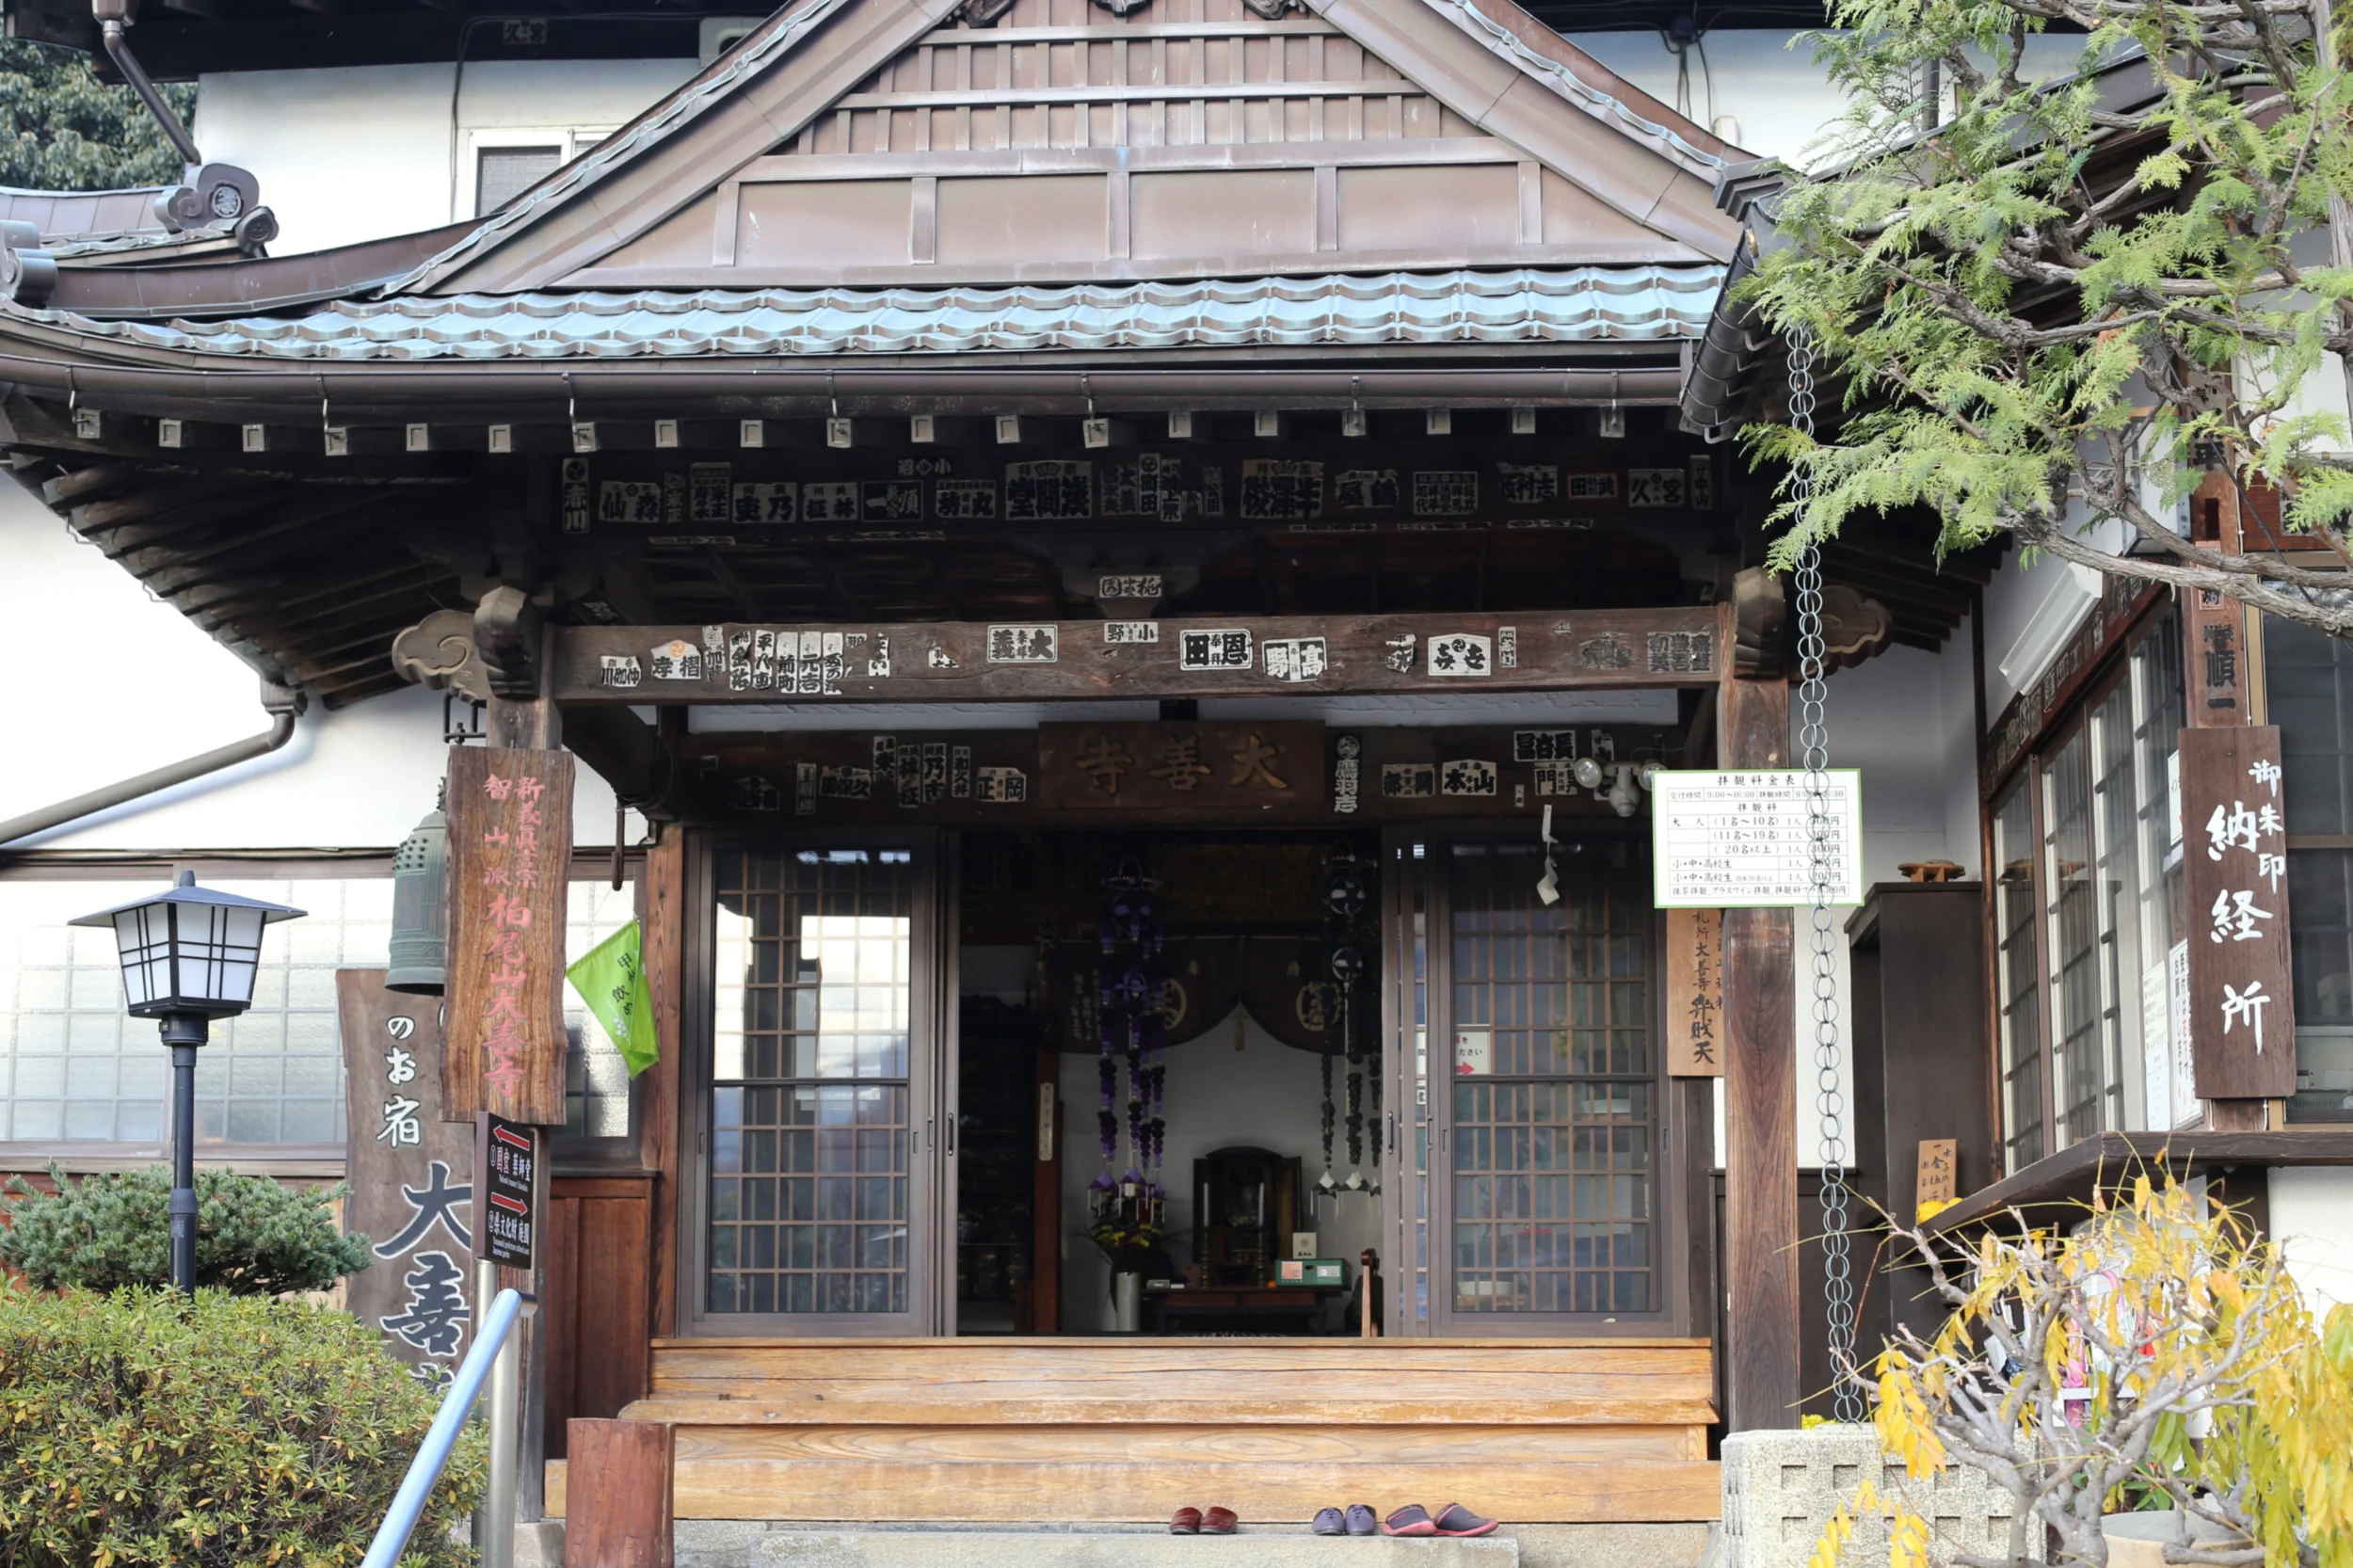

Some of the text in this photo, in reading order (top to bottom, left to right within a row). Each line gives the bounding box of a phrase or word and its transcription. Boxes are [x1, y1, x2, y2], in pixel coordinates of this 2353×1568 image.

[1108, 624, 1155, 641] 小野
[777, 655, 795, 691] 前町
[800, 653, 820, 690] 元吉
[2206, 649, 2240, 710] 順一
[1074, 732, 1288, 795] 大善寺
[1444, 768, 1494, 793] 山本
[1717, 775, 1795, 786] 拝観料金表
[976, 776, 1024, 801] 岡正
[1737, 803, 1777, 813] 拝観料
[484, 773, 512, 887] 智山派
[2249, 759, 2286, 894] 御朱印
[2205, 800, 2274, 1056] 納経所
[482, 893, 533, 1097] 柏尾山大善寺
[377, 1015, 421, 1149] のお宿
